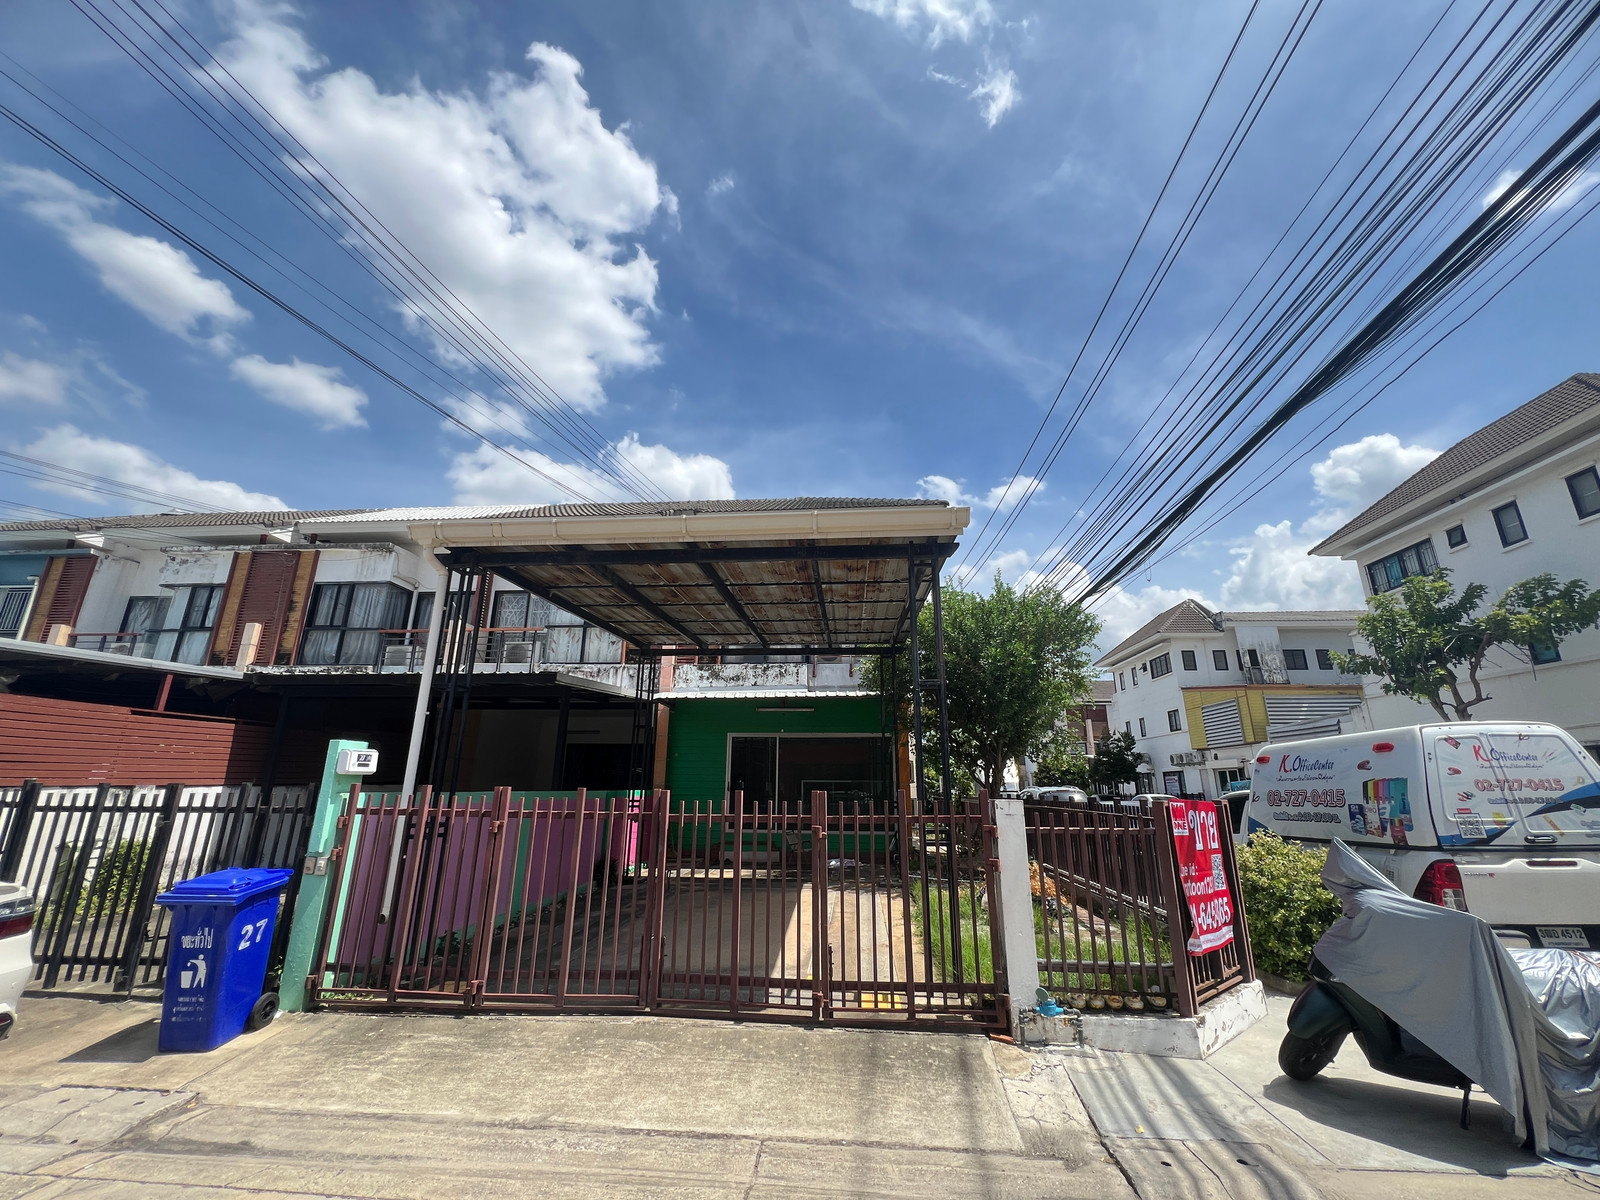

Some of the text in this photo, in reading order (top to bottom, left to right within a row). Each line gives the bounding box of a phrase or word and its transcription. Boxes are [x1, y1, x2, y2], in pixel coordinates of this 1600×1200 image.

[1474, 778, 1565, 792] 02-727-0415
[1267, 788, 1347, 808] 02-727-0415
[1188, 809, 1219, 850] ขาย
[181, 927, 214, 949] ขยะทั่วไป
[238, 918, 269, 951] 27
[1561, 929, 1585, 939] 4512
